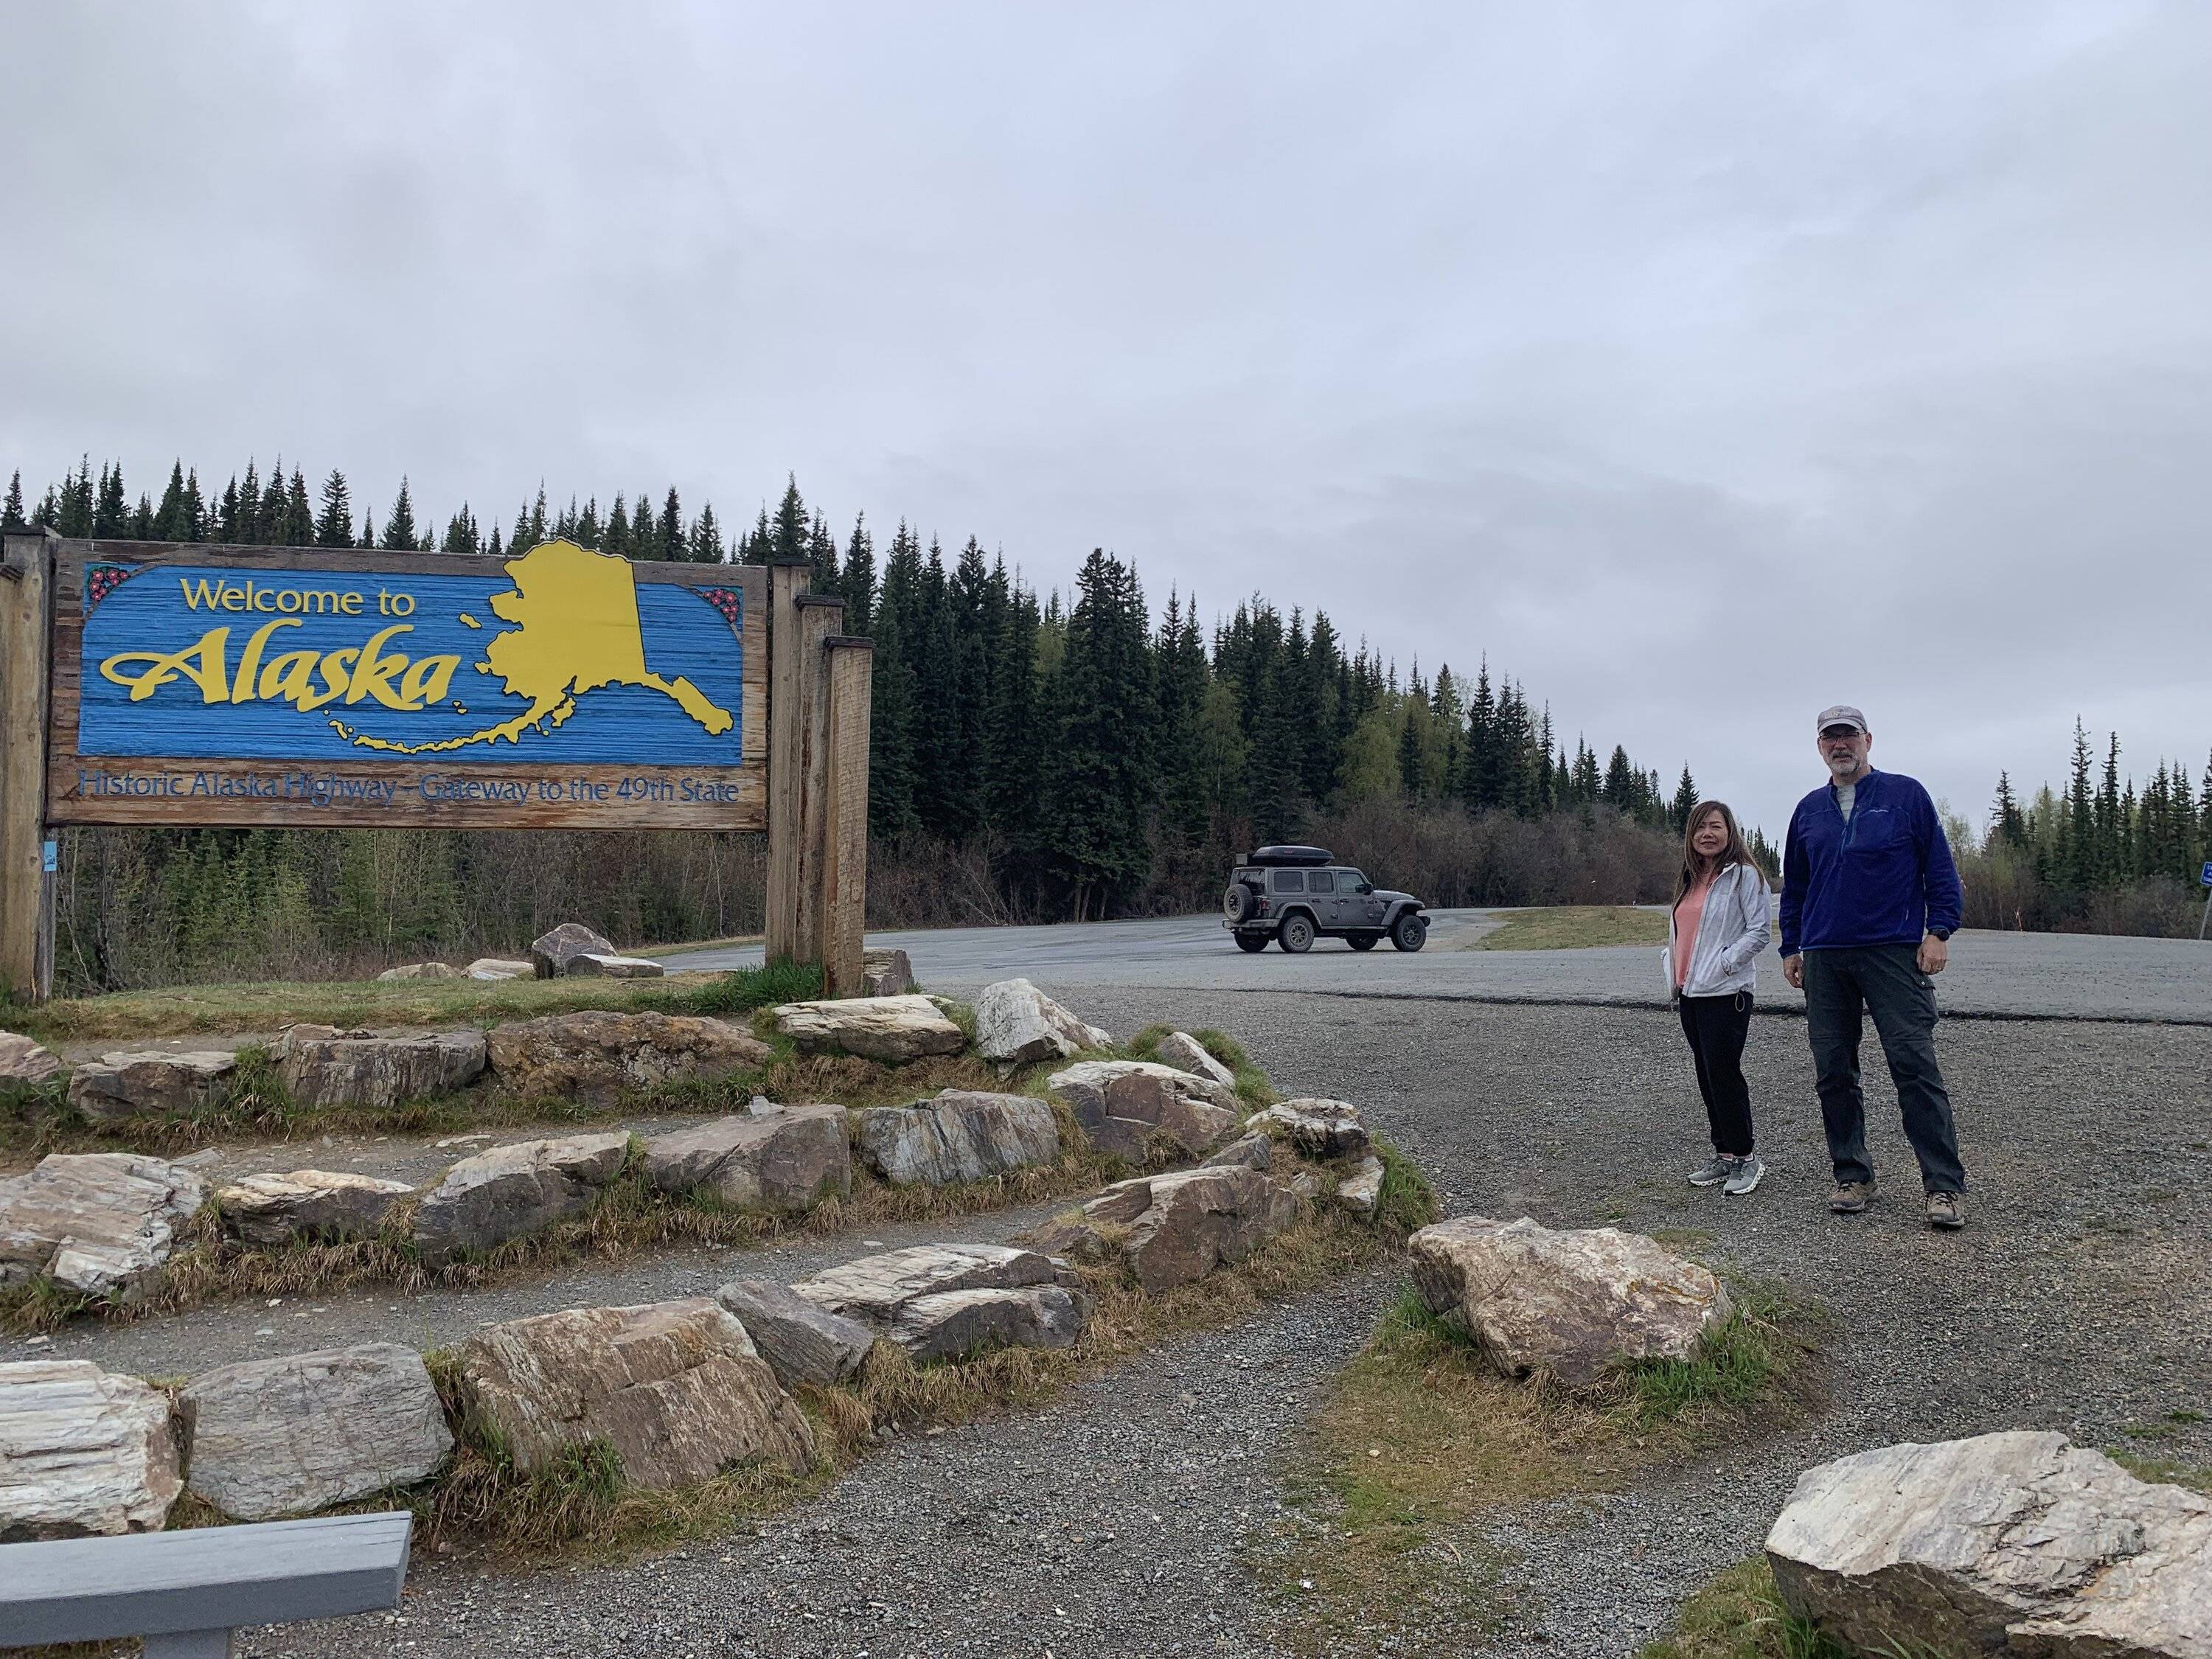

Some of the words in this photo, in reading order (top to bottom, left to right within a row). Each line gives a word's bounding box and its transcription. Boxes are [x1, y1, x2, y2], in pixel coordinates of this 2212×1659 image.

[180, 578, 364, 615] Welcome
[378, 587, 416, 617] to
[99, 618, 462, 713] Alaska
[78, 768, 184, 796] Historic
[190, 771, 278, 797] Alaska
[283, 771, 397, 807] Highway
[420, 773, 532, 807] Gateway
[538, 778, 563, 801] to
[568, 776, 610, 801] the
[616, 776, 674, 801] 49th
[679, 777, 740, 802] State
